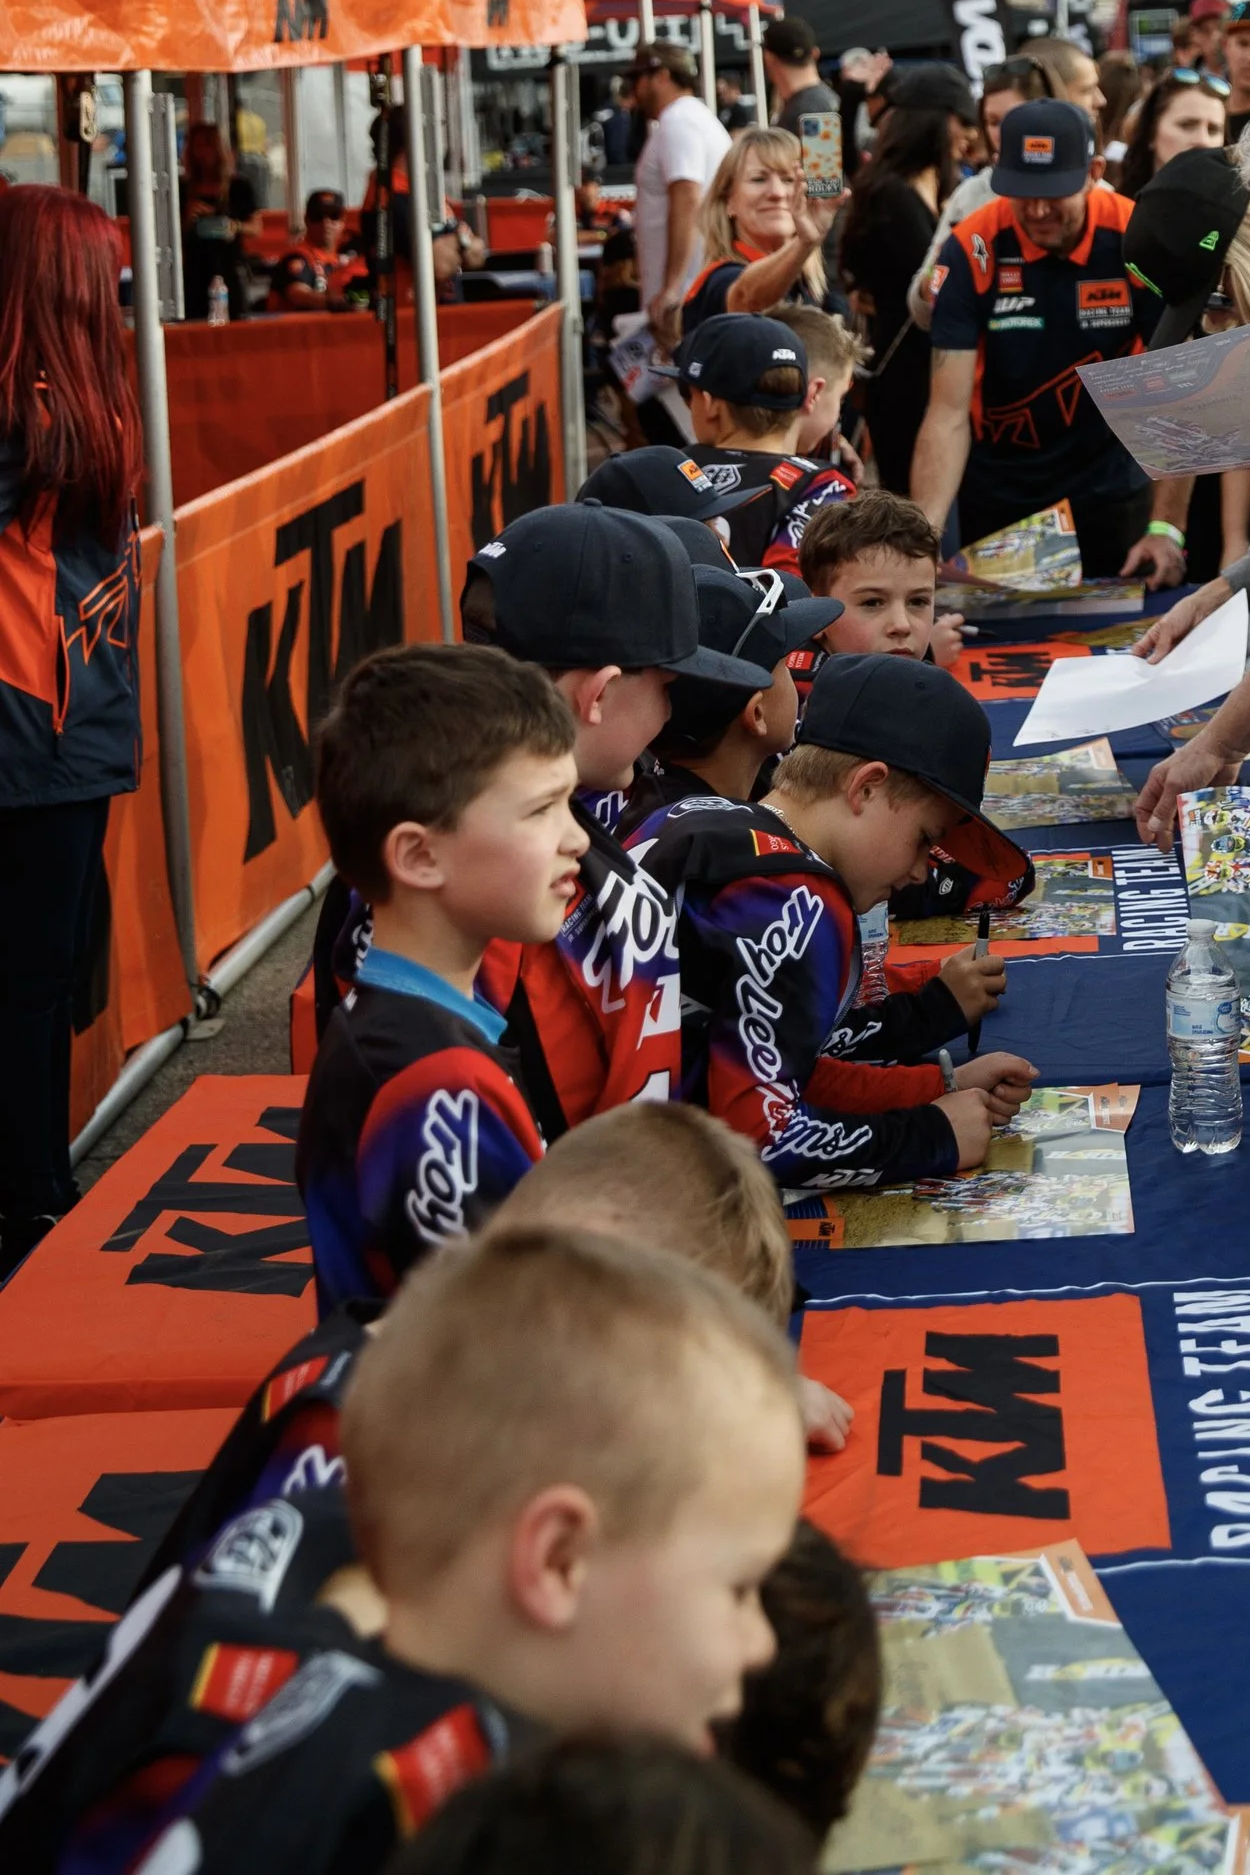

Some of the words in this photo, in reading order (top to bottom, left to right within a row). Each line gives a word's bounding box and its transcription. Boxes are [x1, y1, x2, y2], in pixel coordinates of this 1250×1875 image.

[1111, 847, 1181, 886] TEAM
[737, 885, 824, 987] Troy
[1118, 887, 1190, 952] RACING
[736, 974, 784, 1083] Lee
[404, 1088, 478, 1247] Troy
[877, 1329, 1070, 1520] KTM
